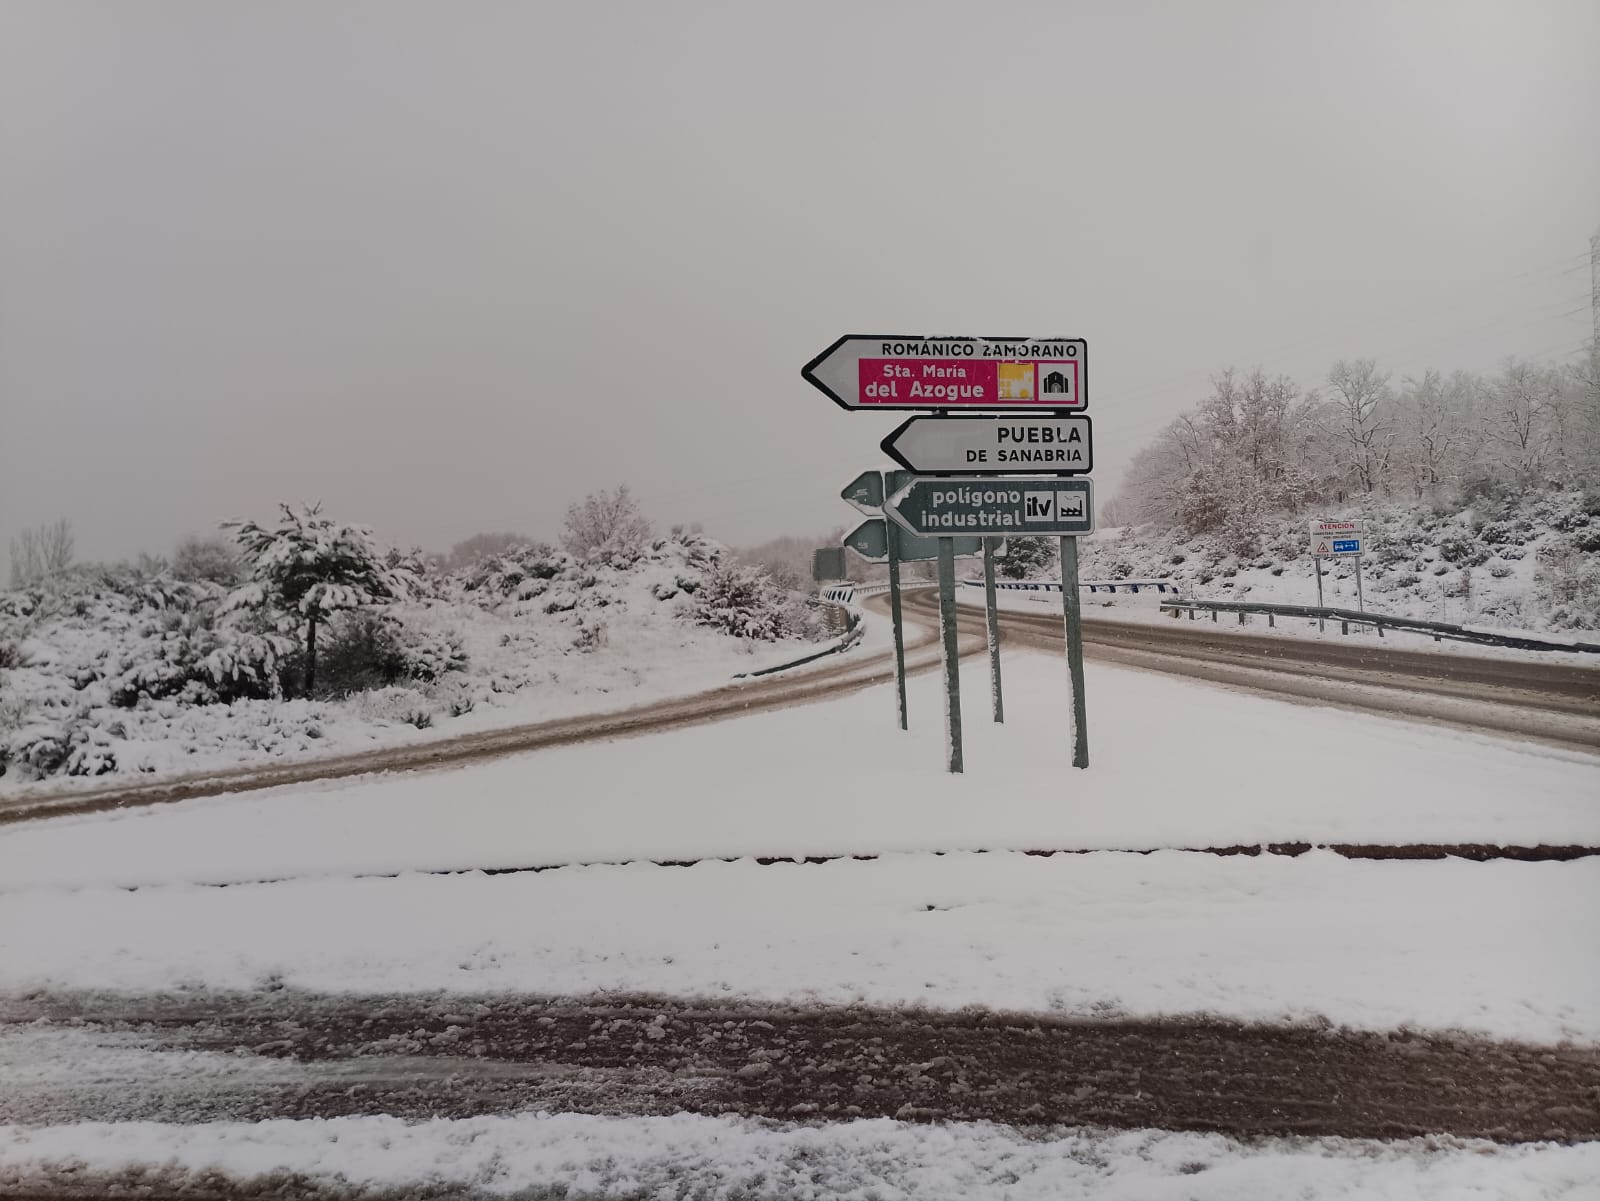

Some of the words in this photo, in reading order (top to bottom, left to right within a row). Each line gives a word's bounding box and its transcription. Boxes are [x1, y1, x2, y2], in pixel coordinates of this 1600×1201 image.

[882, 340, 974, 356] ROMÁNICO
[983, 344, 1077, 357] ZAMORANO
[883, 364, 915, 378] Sta.
[922, 364, 966, 378] María
[865, 381, 898, 397] del
[910, 381, 984, 400] Azogue
[998, 427, 1082, 443] PUEBLA
[966, 450, 987, 462] DE
[998, 450, 1082, 462] SANABRIA
[932, 488, 1020, 507] polígono
[922, 510, 1021, 526] industrial
